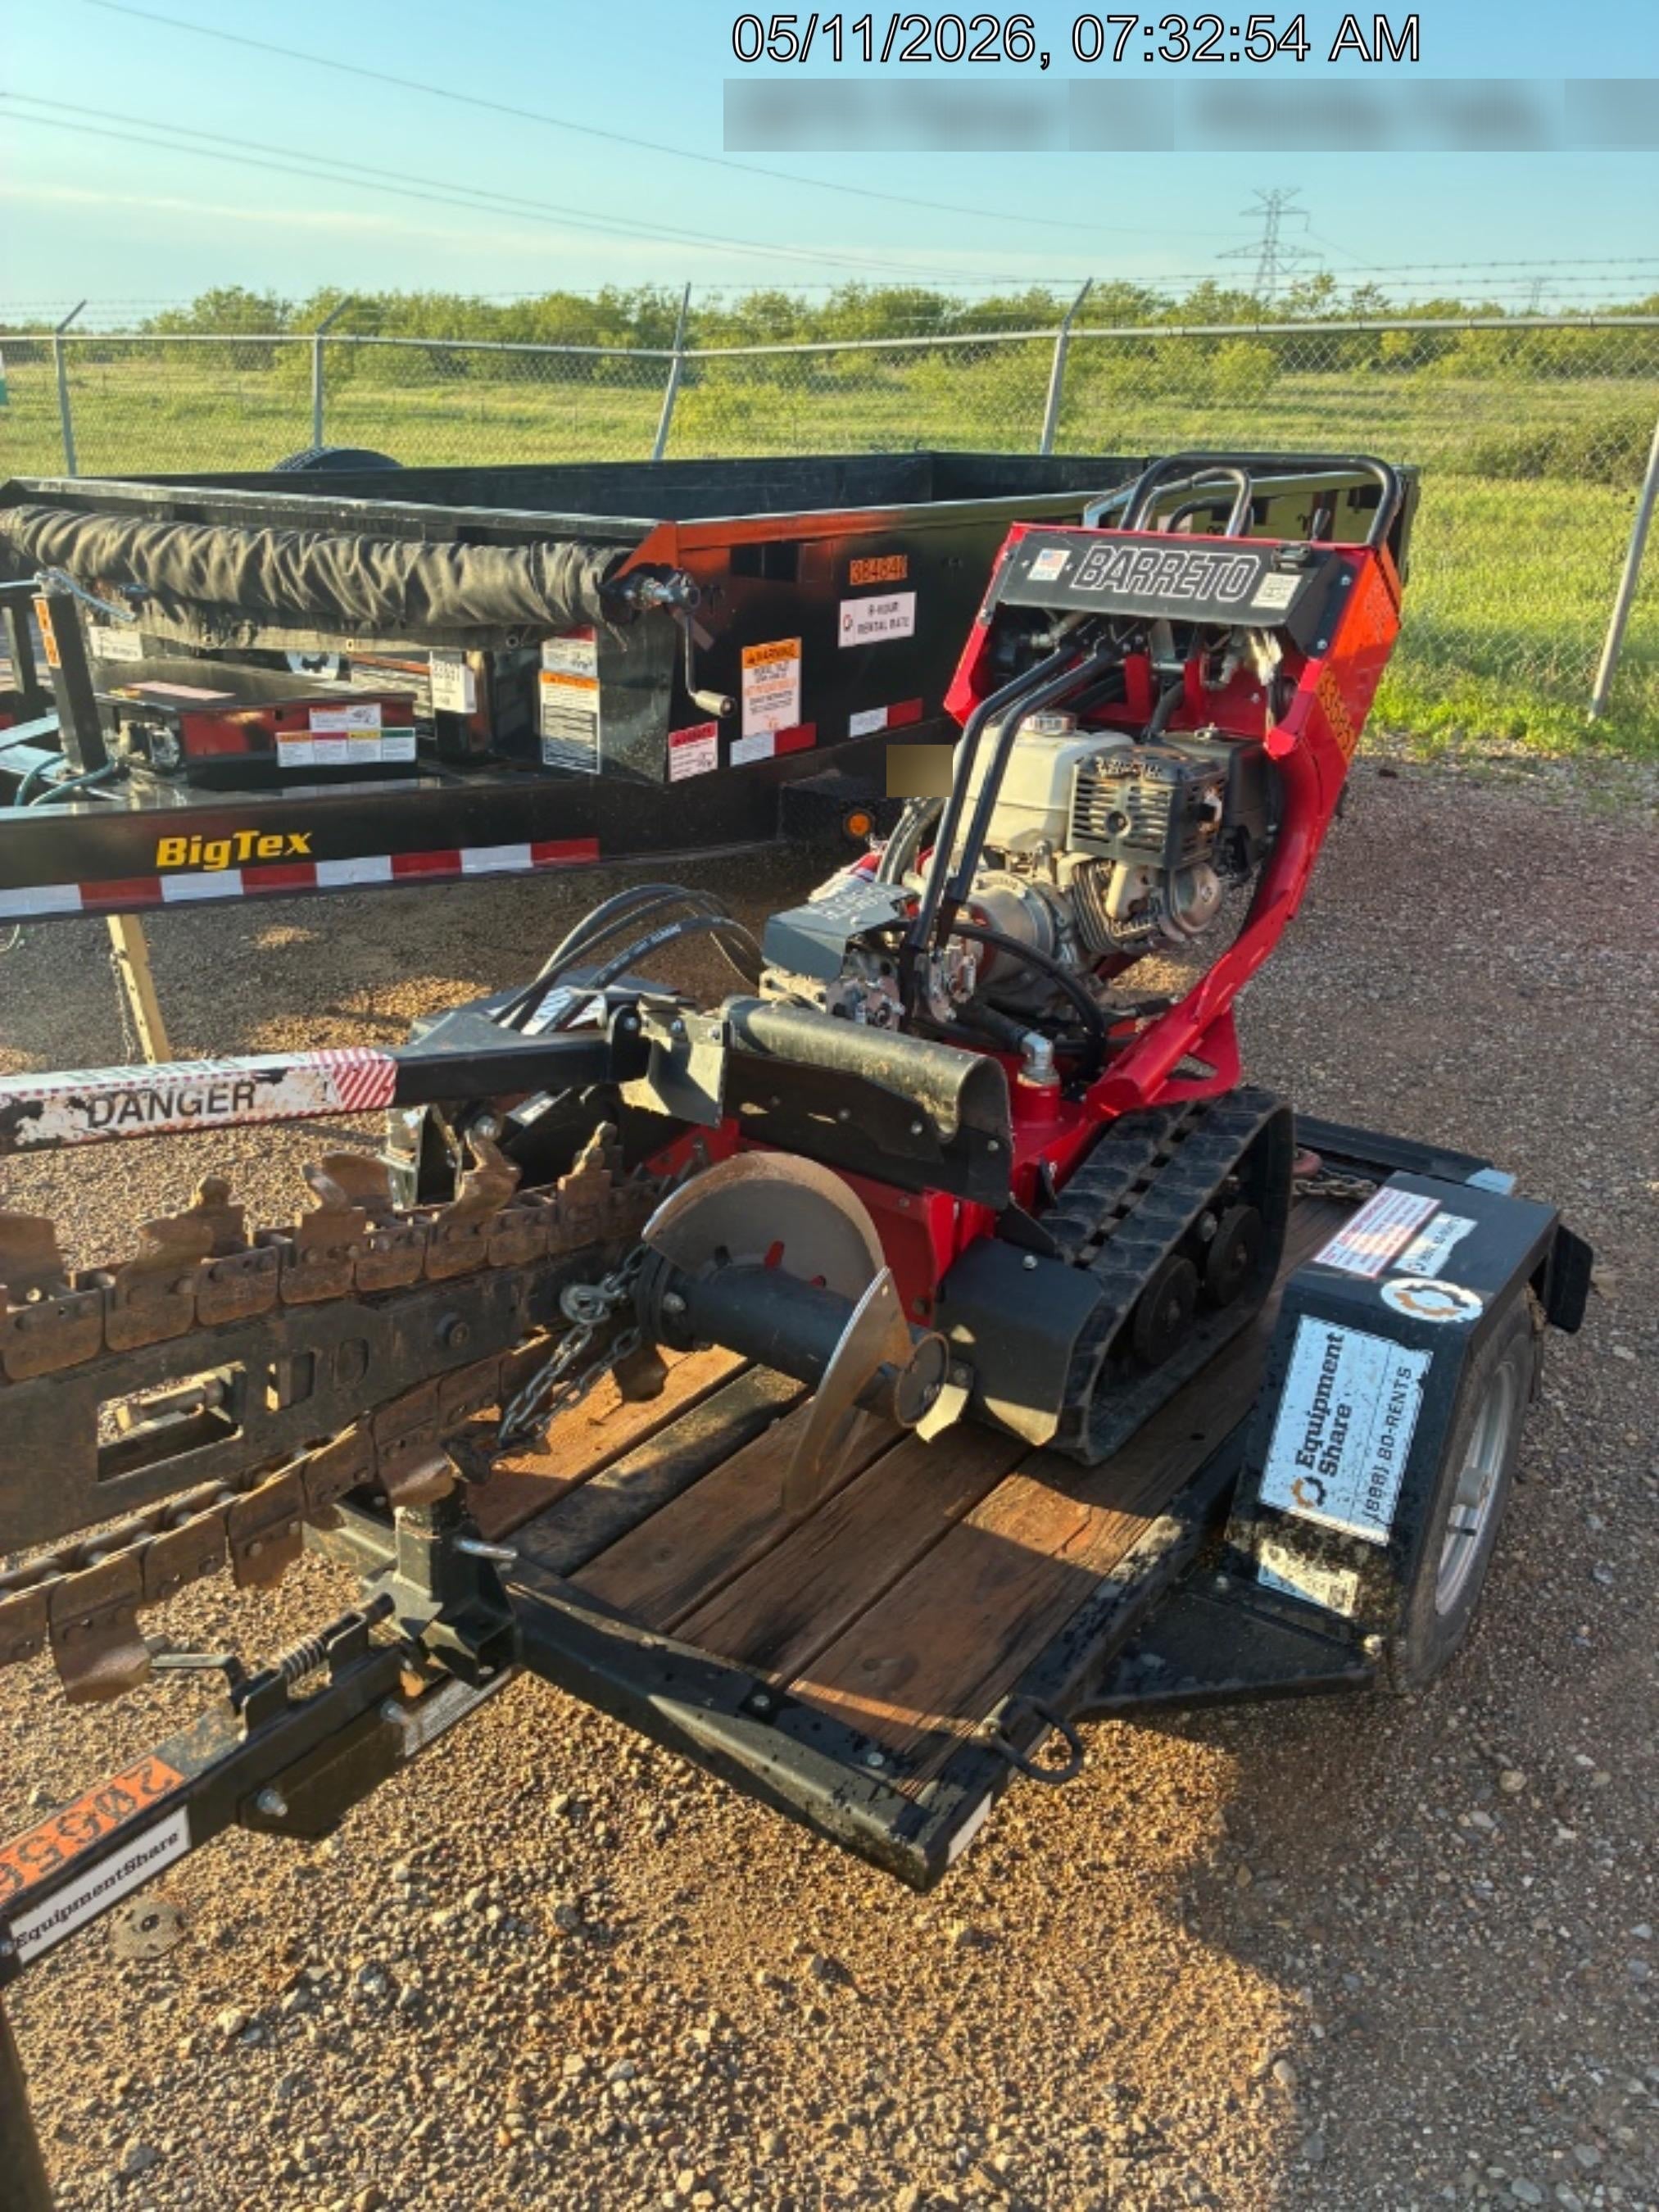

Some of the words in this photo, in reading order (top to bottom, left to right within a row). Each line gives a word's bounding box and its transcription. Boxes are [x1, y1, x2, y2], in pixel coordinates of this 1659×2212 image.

[1068, 545, 1262, 602] BARRETO
[156, 829, 312, 871] BigTex
[86, 1080, 257, 1129] DANGER
[1294, 1331, 1345, 1471] Equipment
[1317, 1402, 1353, 1477] Share
[16, 1830, 179, 1948] EquipmentShare
